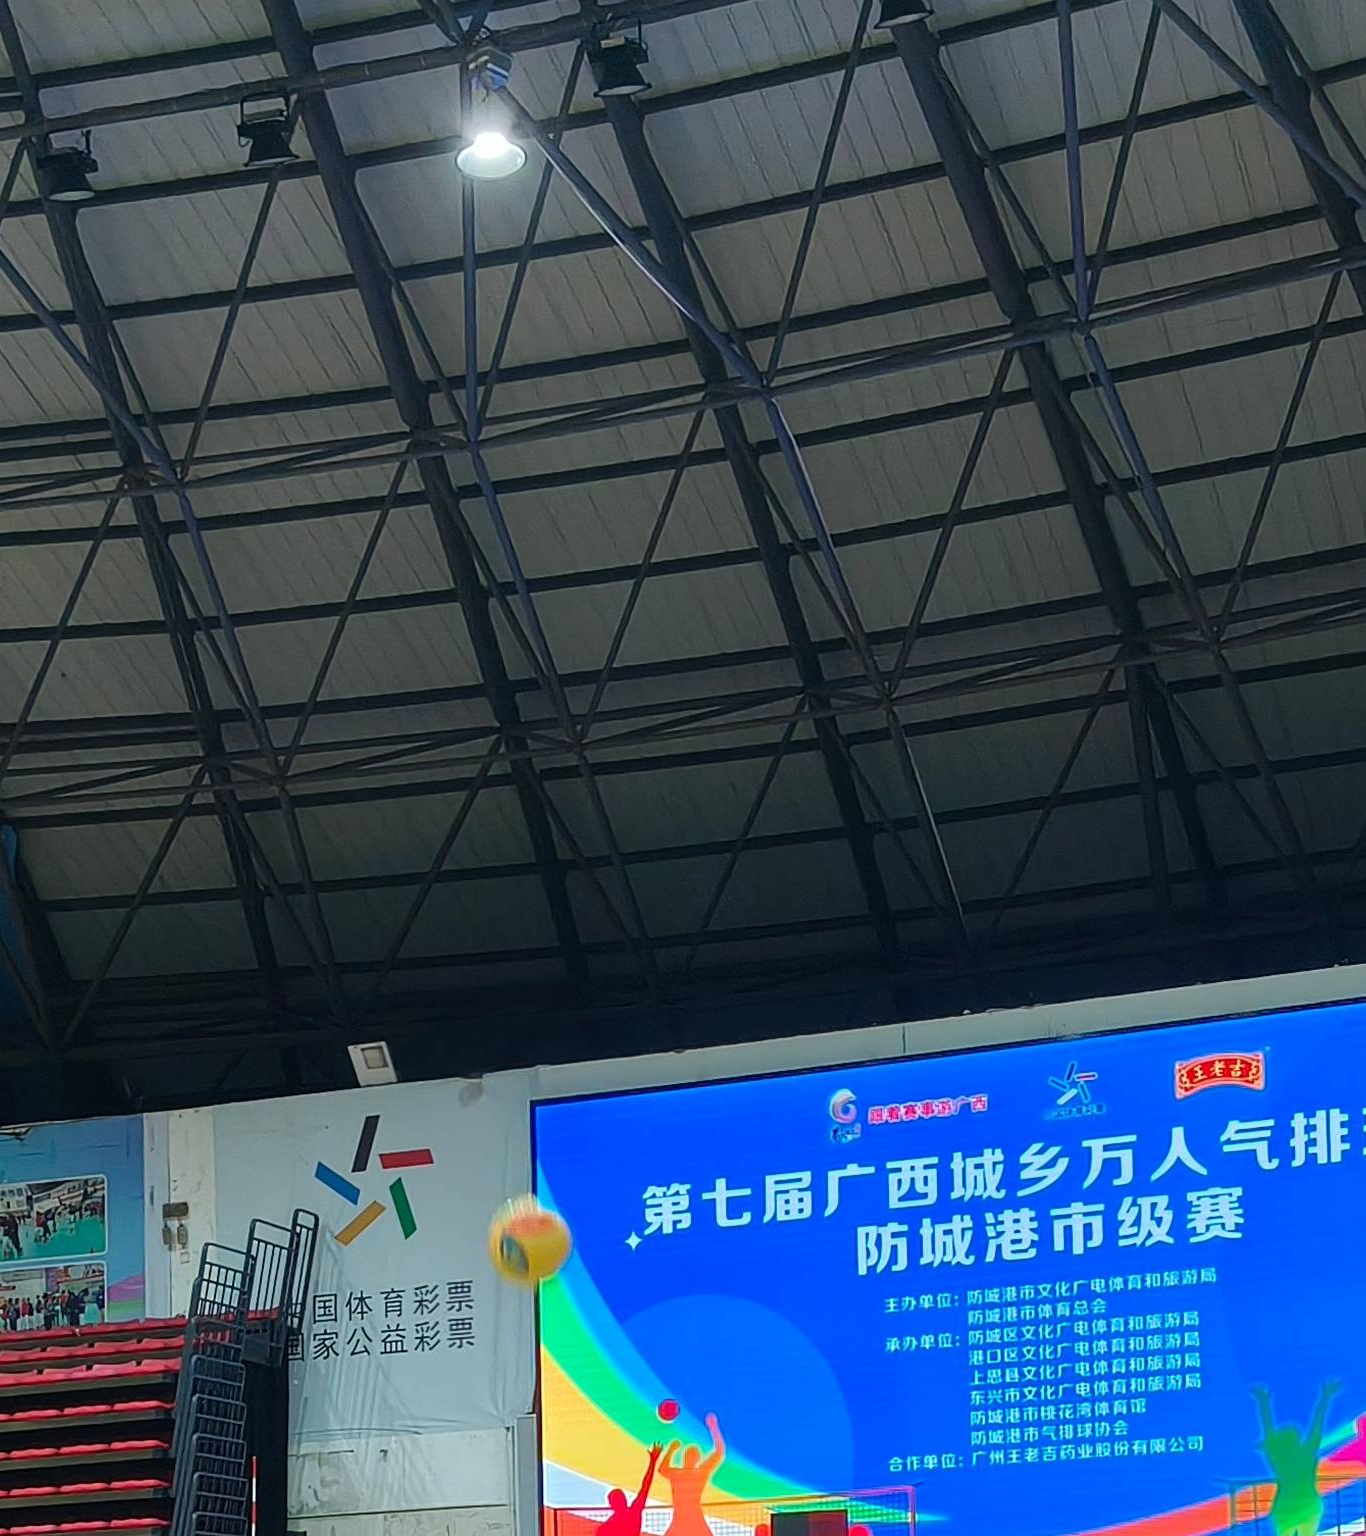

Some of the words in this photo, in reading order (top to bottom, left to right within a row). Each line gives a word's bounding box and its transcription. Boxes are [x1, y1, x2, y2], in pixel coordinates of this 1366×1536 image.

[1192, 1058, 1245, 1083] 王老吉
[856, 1185, 1245, 1277] 防城港市级赛
[884, 1293, 960, 1313] 主办单位：
[967, 1267, 1218, 1305] 防城港市文化广电体育和旅游局
[968, 1298, 1108, 1326] 防城港市体育总会
[287, 1317, 476, 1362] 国家公益彩票
[885, 1333, 961, 1353] 承办单位：
[968, 1311, 1200, 1346] 防城区文化广电体育和旅游局
[968, 1332, 1201, 1366] 港口区文化广电体育和旅游局
[969, 1352, 1202, 1386] 上思县文化广电体育和旅游局
[970, 1373, 1202, 1407] 东兴市文化广电体育和旅游局
[970, 1398, 1147, 1427] 防城港市桃花湾体育馆
[971, 1420, 1130, 1447] 防城港市气排球协会
[888, 1454, 964, 1473] 合作单位：
[971, 1436, 1204, 1467] 广州王老吉药业股份有限公司
